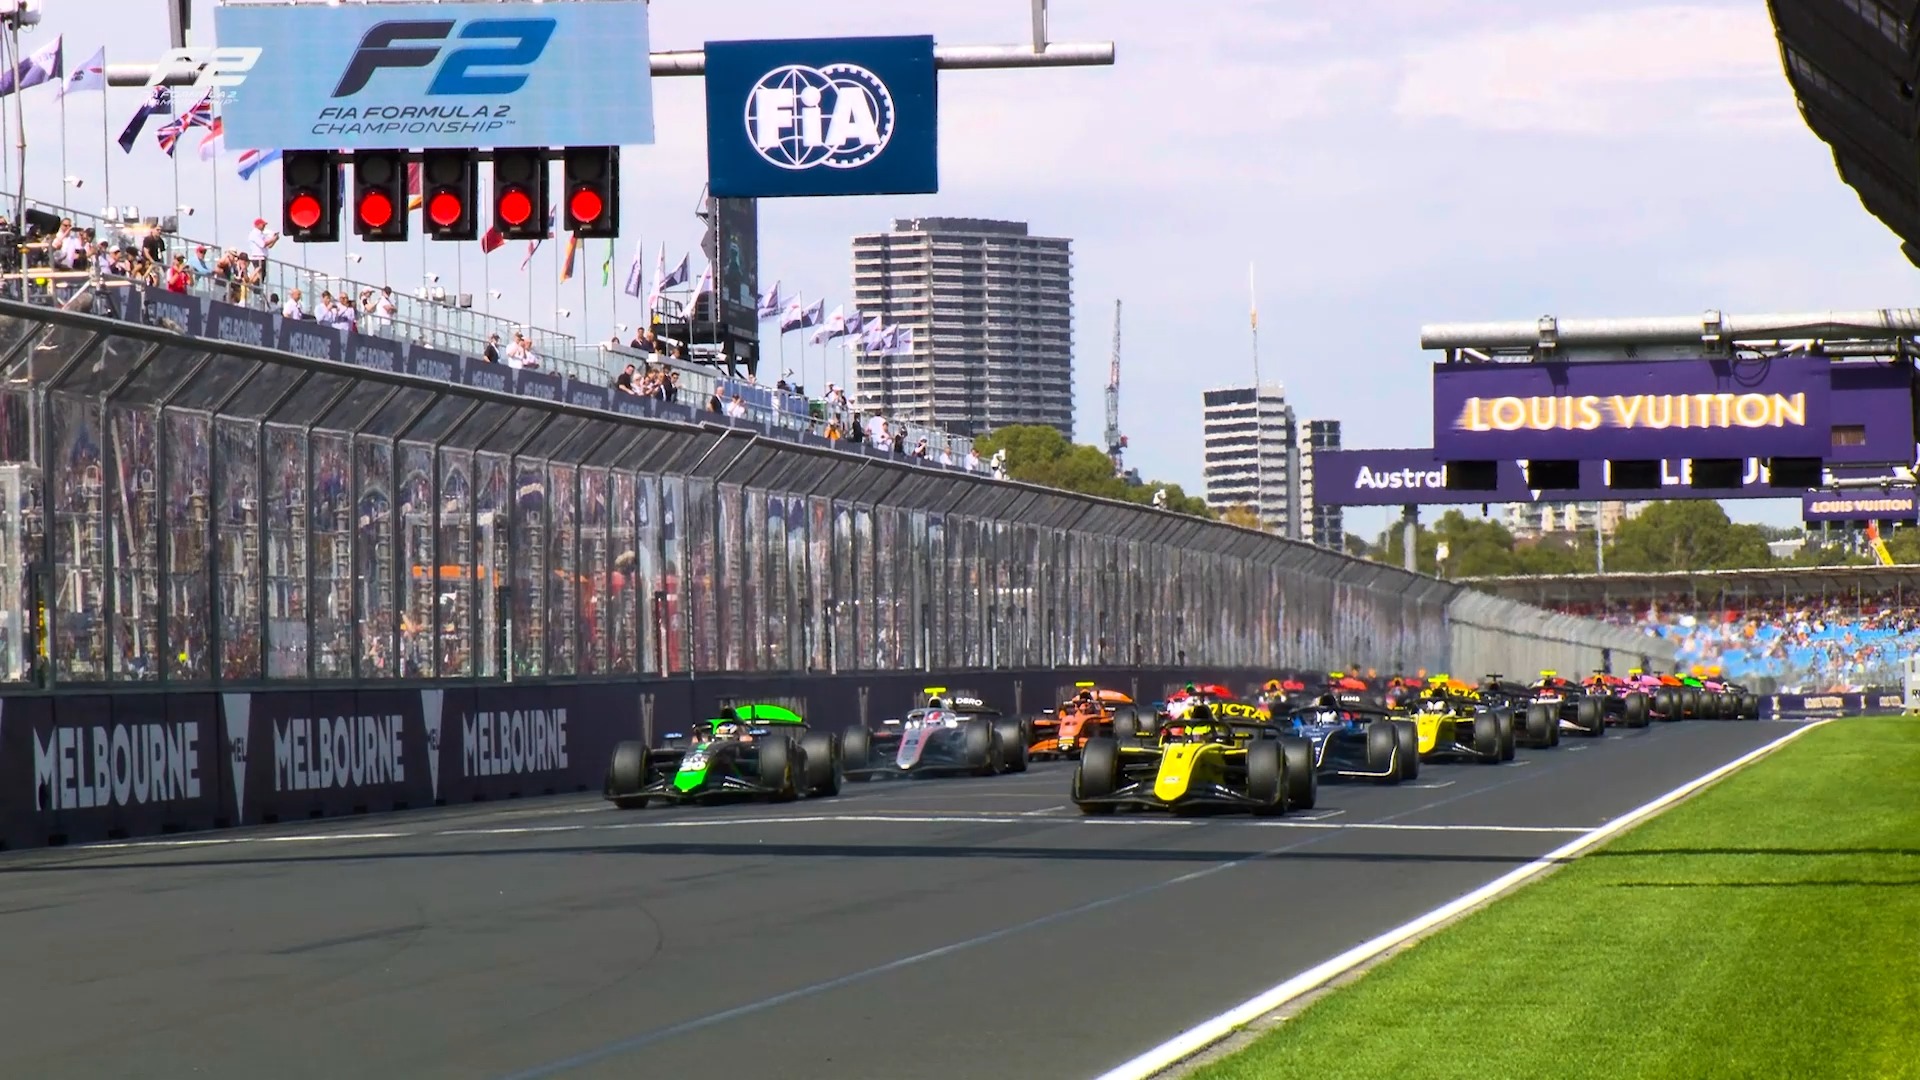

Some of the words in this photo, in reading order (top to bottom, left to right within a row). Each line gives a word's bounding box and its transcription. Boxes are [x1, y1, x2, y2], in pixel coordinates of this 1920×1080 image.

[331, 18, 557, 98] F2
[318, 107, 357, 119] FIA
[362, 105, 489, 119] FORMULA
[492, 105, 512, 118] 2
[218, 316, 263, 347] MELBOURNE
[289, 332, 331, 360] MELBOURNE
[1463, 395, 1600, 431] LOUIS
[1612, 392, 1806, 430] VUITTON
[1354, 464, 1448, 489] Austral
[1810, 501, 1853, 513] LOUIS
[1855, 499, 1912, 512] VUITTON
[273, 714, 405, 791] MELBOURNE
[462, 708, 569, 777] MELBOURNE
[33, 722, 201, 811] MELBOURNE
